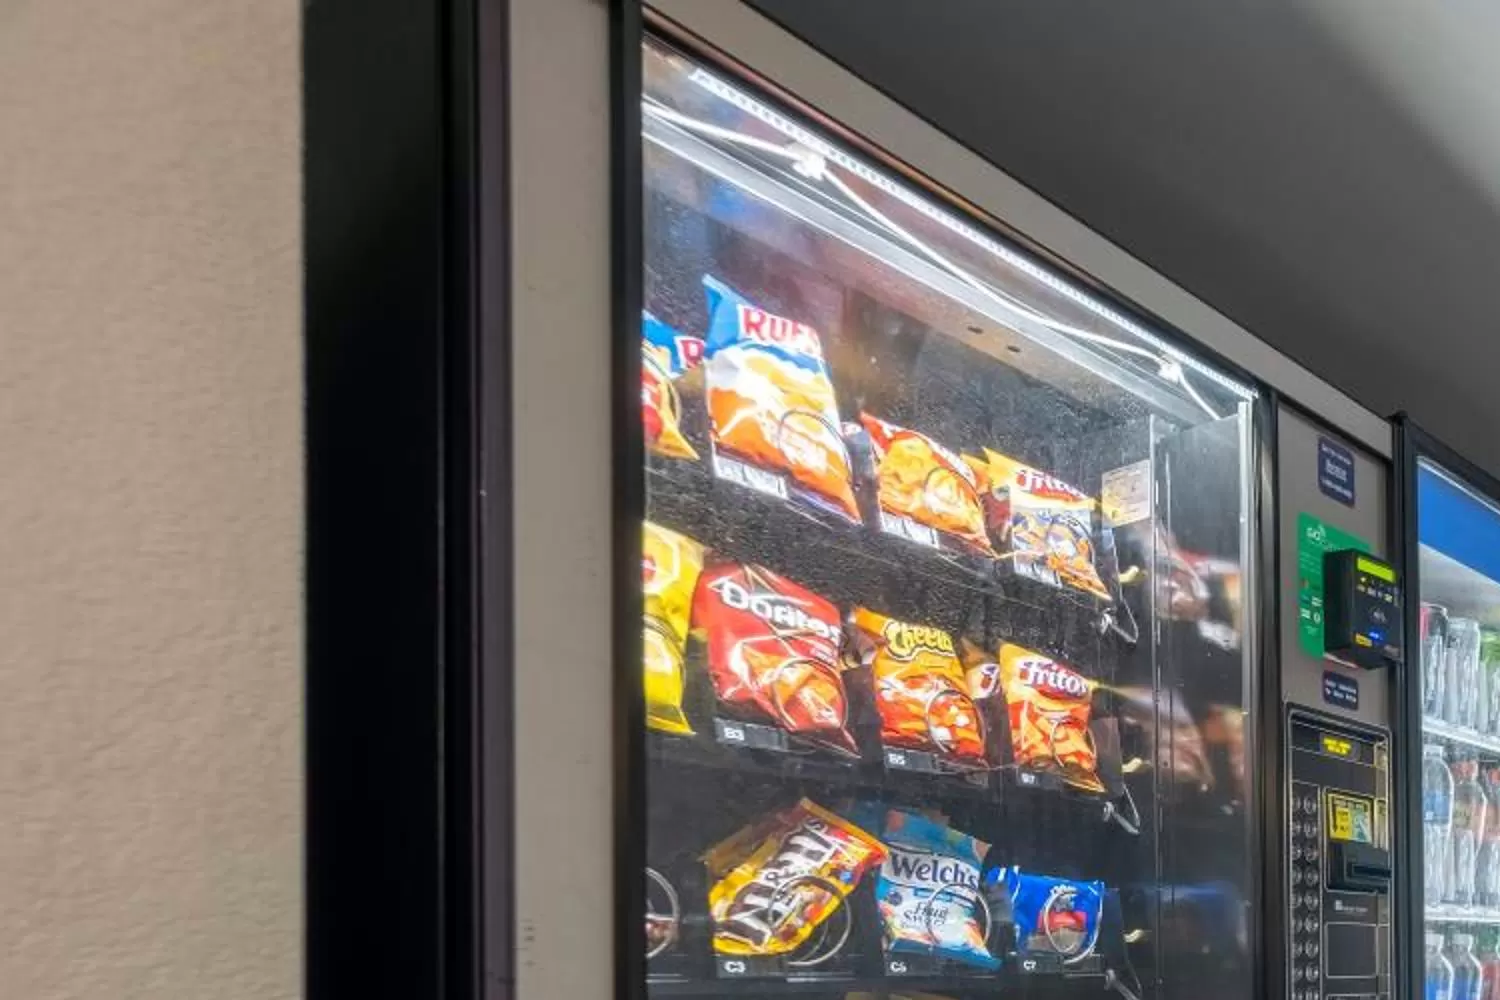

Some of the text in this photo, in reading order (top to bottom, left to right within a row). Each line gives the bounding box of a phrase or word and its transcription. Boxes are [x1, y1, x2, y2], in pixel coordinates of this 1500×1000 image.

[884, 619, 953, 657] Cheeto
[890, 850, 979, 890] Welch's
[723, 960, 747, 974] C3
